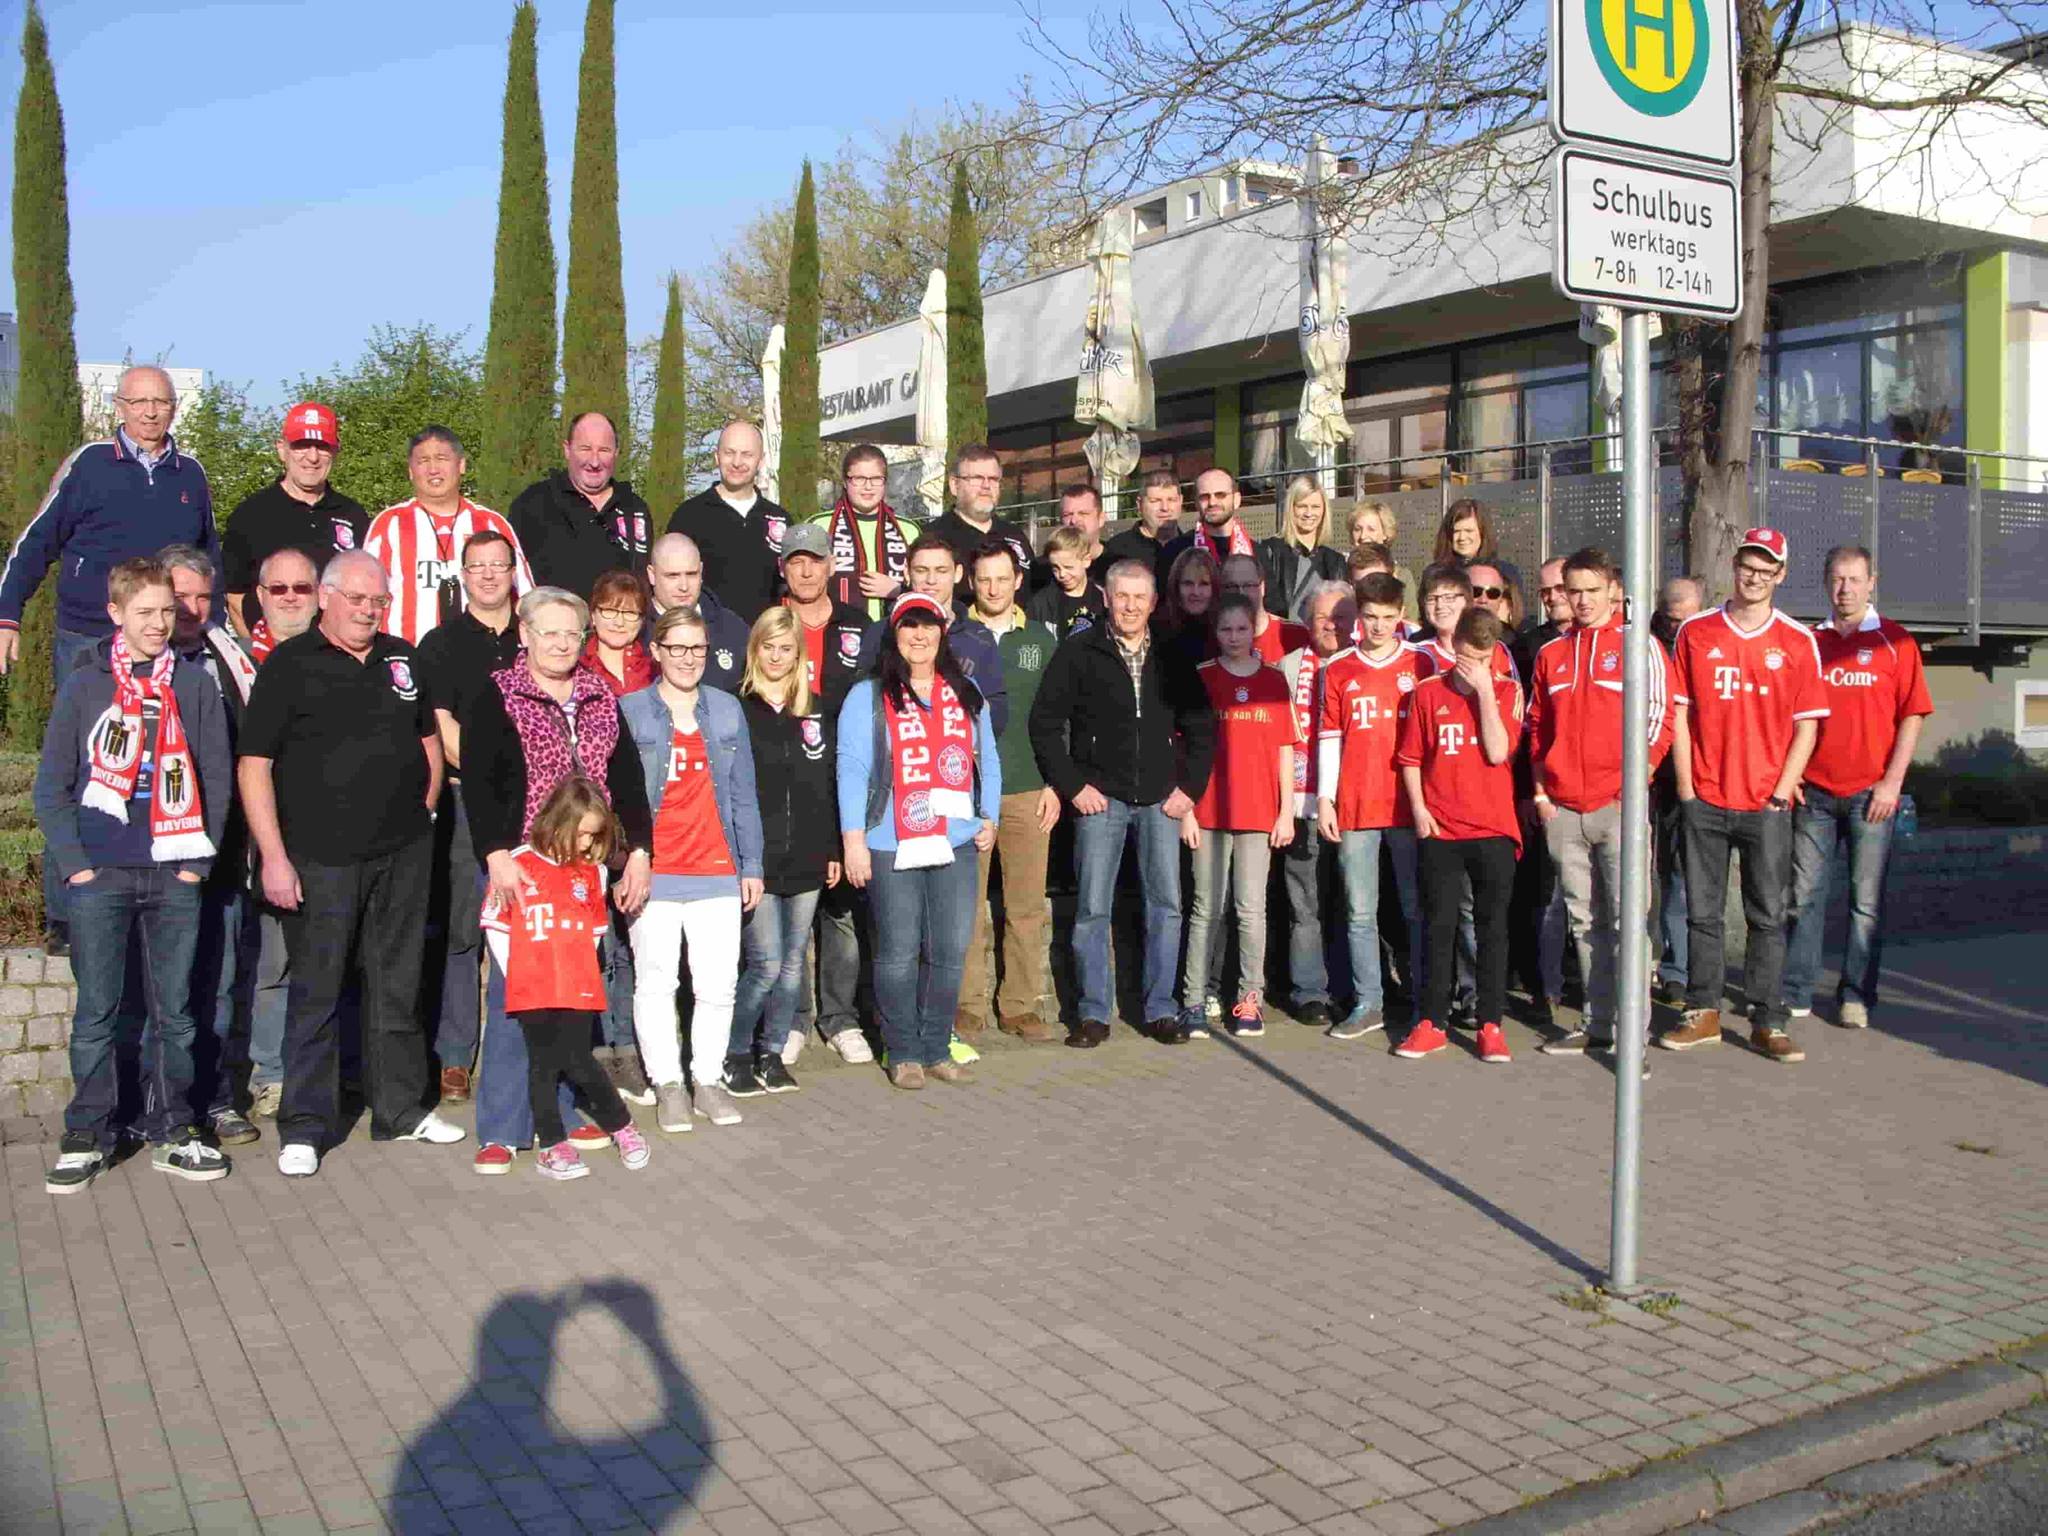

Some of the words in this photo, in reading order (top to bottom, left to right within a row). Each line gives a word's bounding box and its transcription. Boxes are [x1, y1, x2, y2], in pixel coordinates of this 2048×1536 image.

[1625, 0, 1674, 79] H
[1592, 178, 1713, 229] Schulbus
[1611, 230, 1697, 263] werktags
[901, 746, 931, 785] FC
